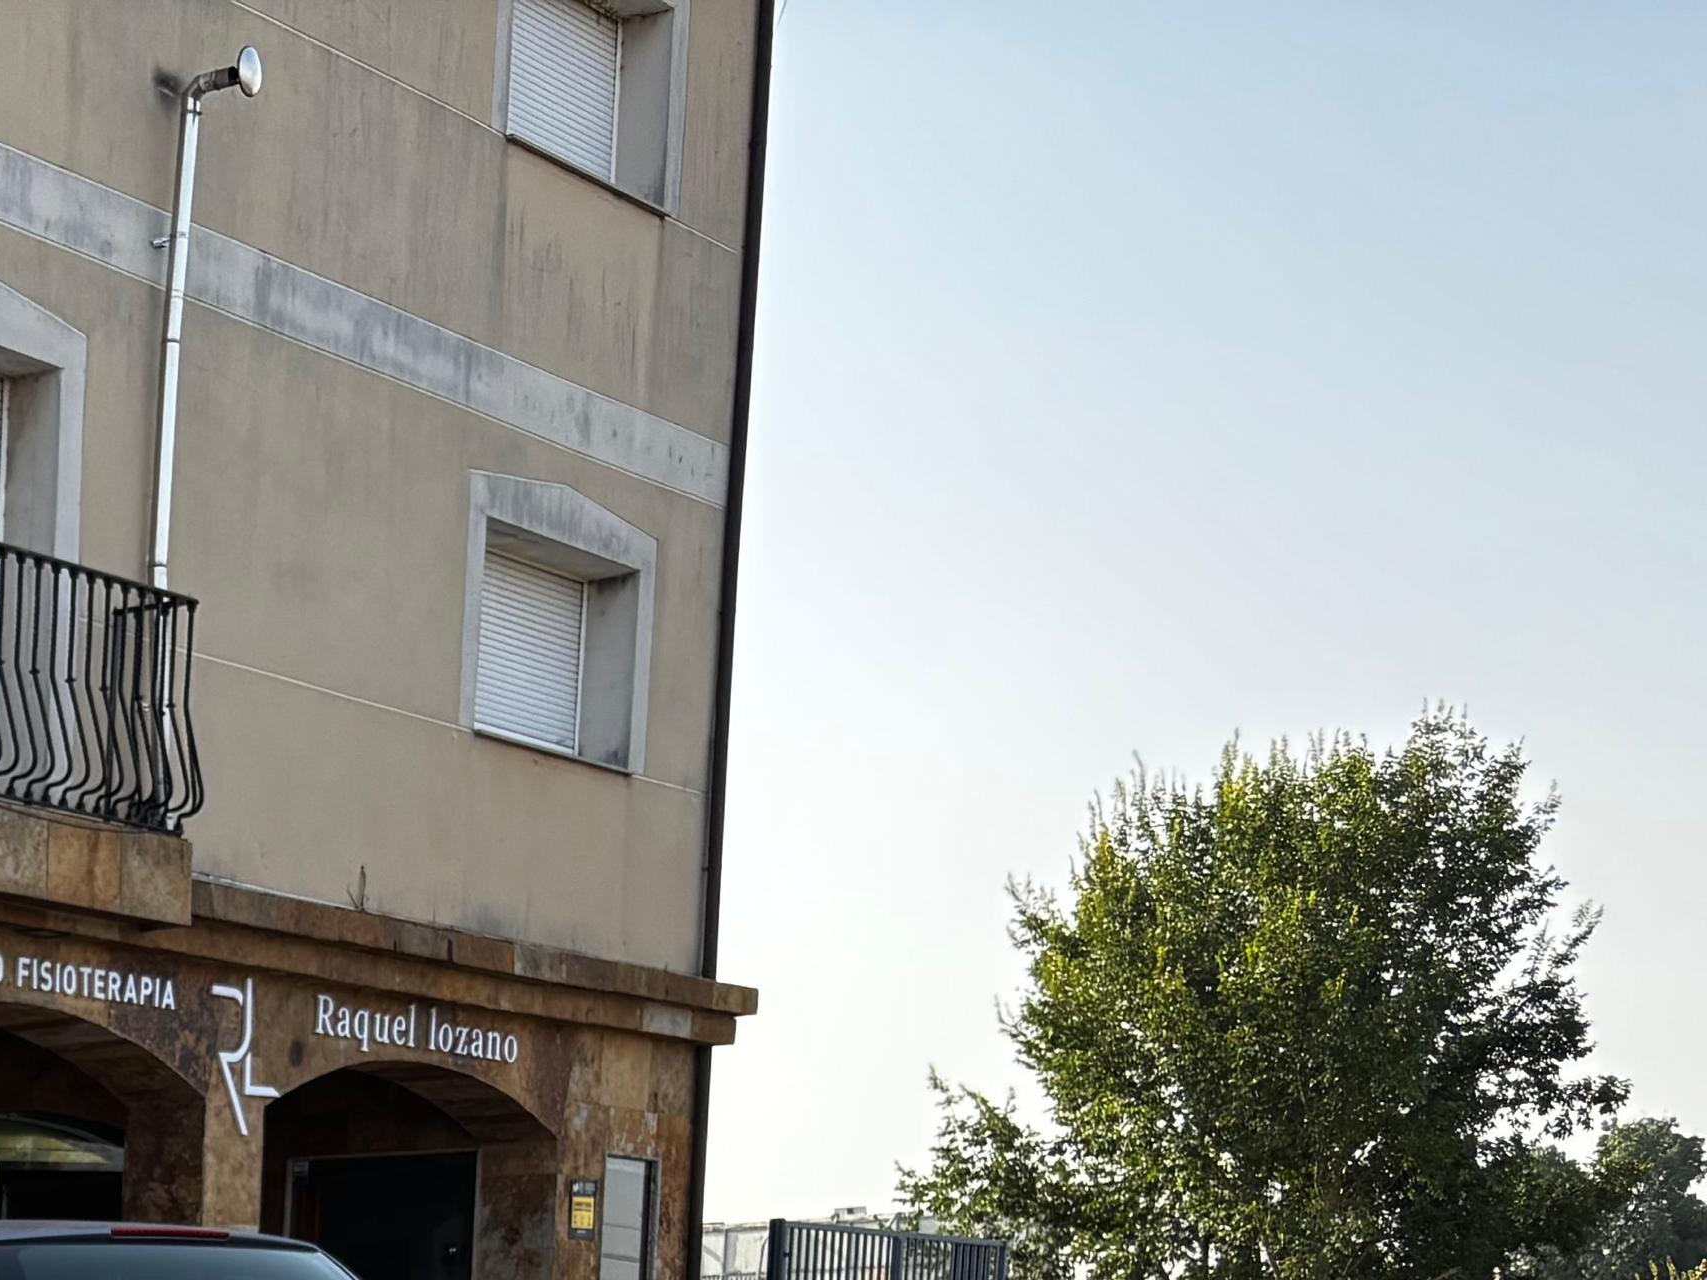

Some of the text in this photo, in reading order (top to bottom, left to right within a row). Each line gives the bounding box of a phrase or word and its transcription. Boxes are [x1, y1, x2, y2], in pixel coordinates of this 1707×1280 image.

[16, 956, 176, 1011] FISIOTERAPIA
[315, 994, 520, 1064] Raquel lozano
